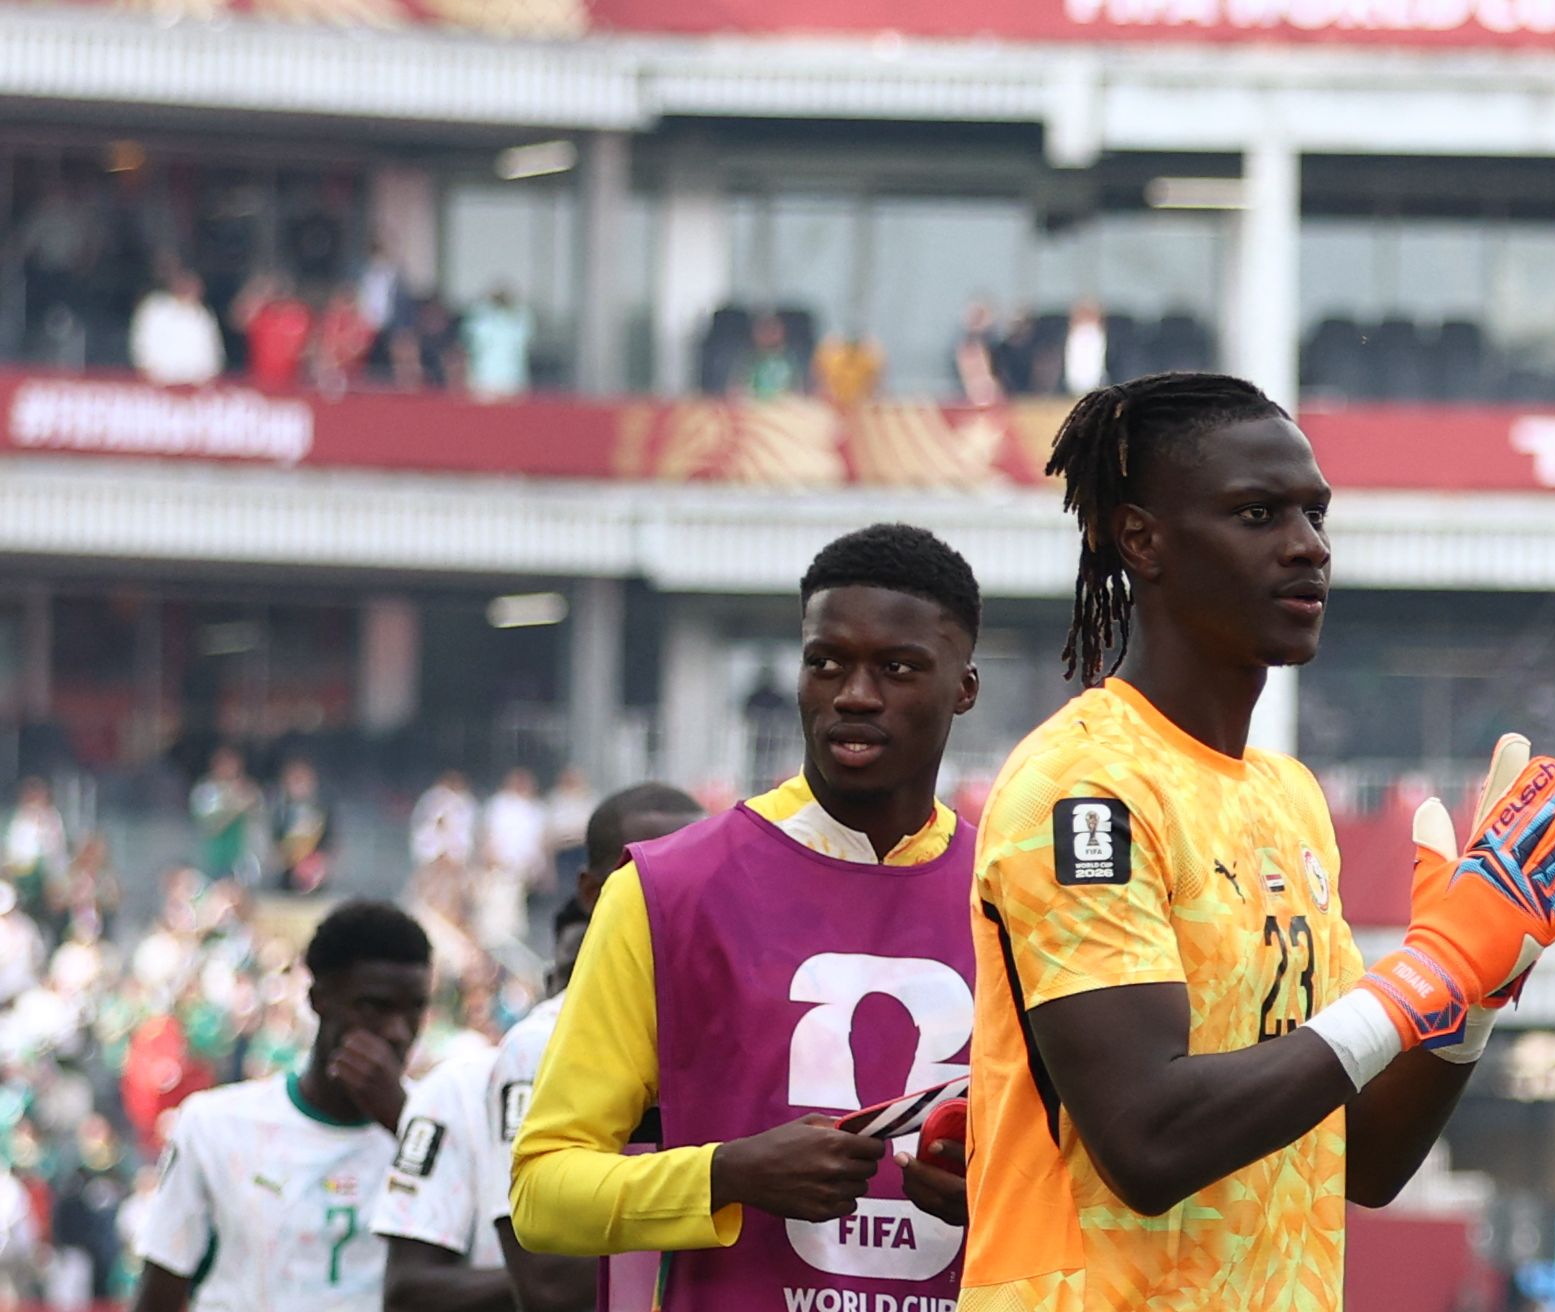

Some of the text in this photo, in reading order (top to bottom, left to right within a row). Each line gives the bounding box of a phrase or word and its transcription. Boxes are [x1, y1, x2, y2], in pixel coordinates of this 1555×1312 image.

[1075, 868, 1114, 878] 2026
[1258, 915, 1314, 1043] 23
[326, 1205, 358, 1285] 7
[838, 1214, 917, 1250] FIFA
